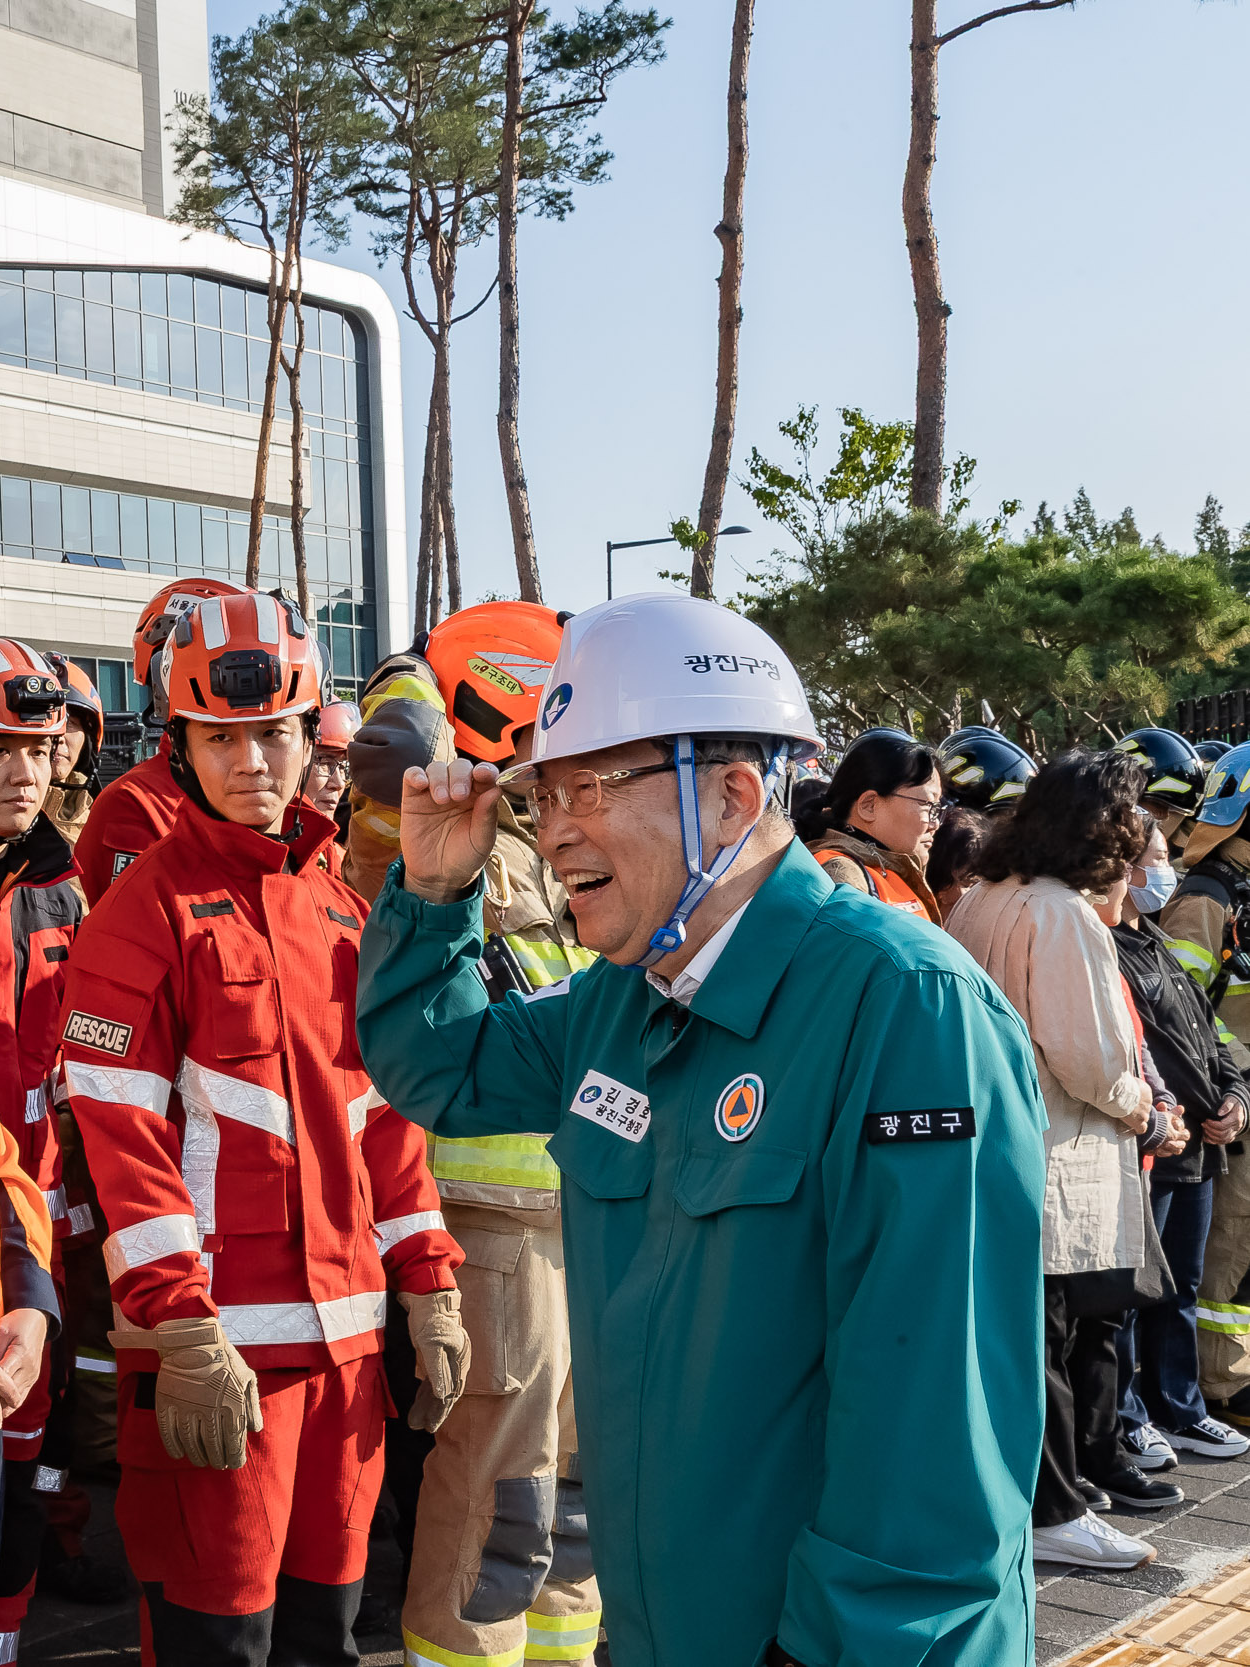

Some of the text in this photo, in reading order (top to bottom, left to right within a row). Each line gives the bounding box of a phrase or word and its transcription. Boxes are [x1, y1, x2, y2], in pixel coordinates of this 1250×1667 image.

[487, 668, 518, 693] 구조대
[683, 654, 781, 681] 광진구청
[67, 1015, 128, 1052] RESCUE
[595, 1103, 643, 1135] 광진구청장
